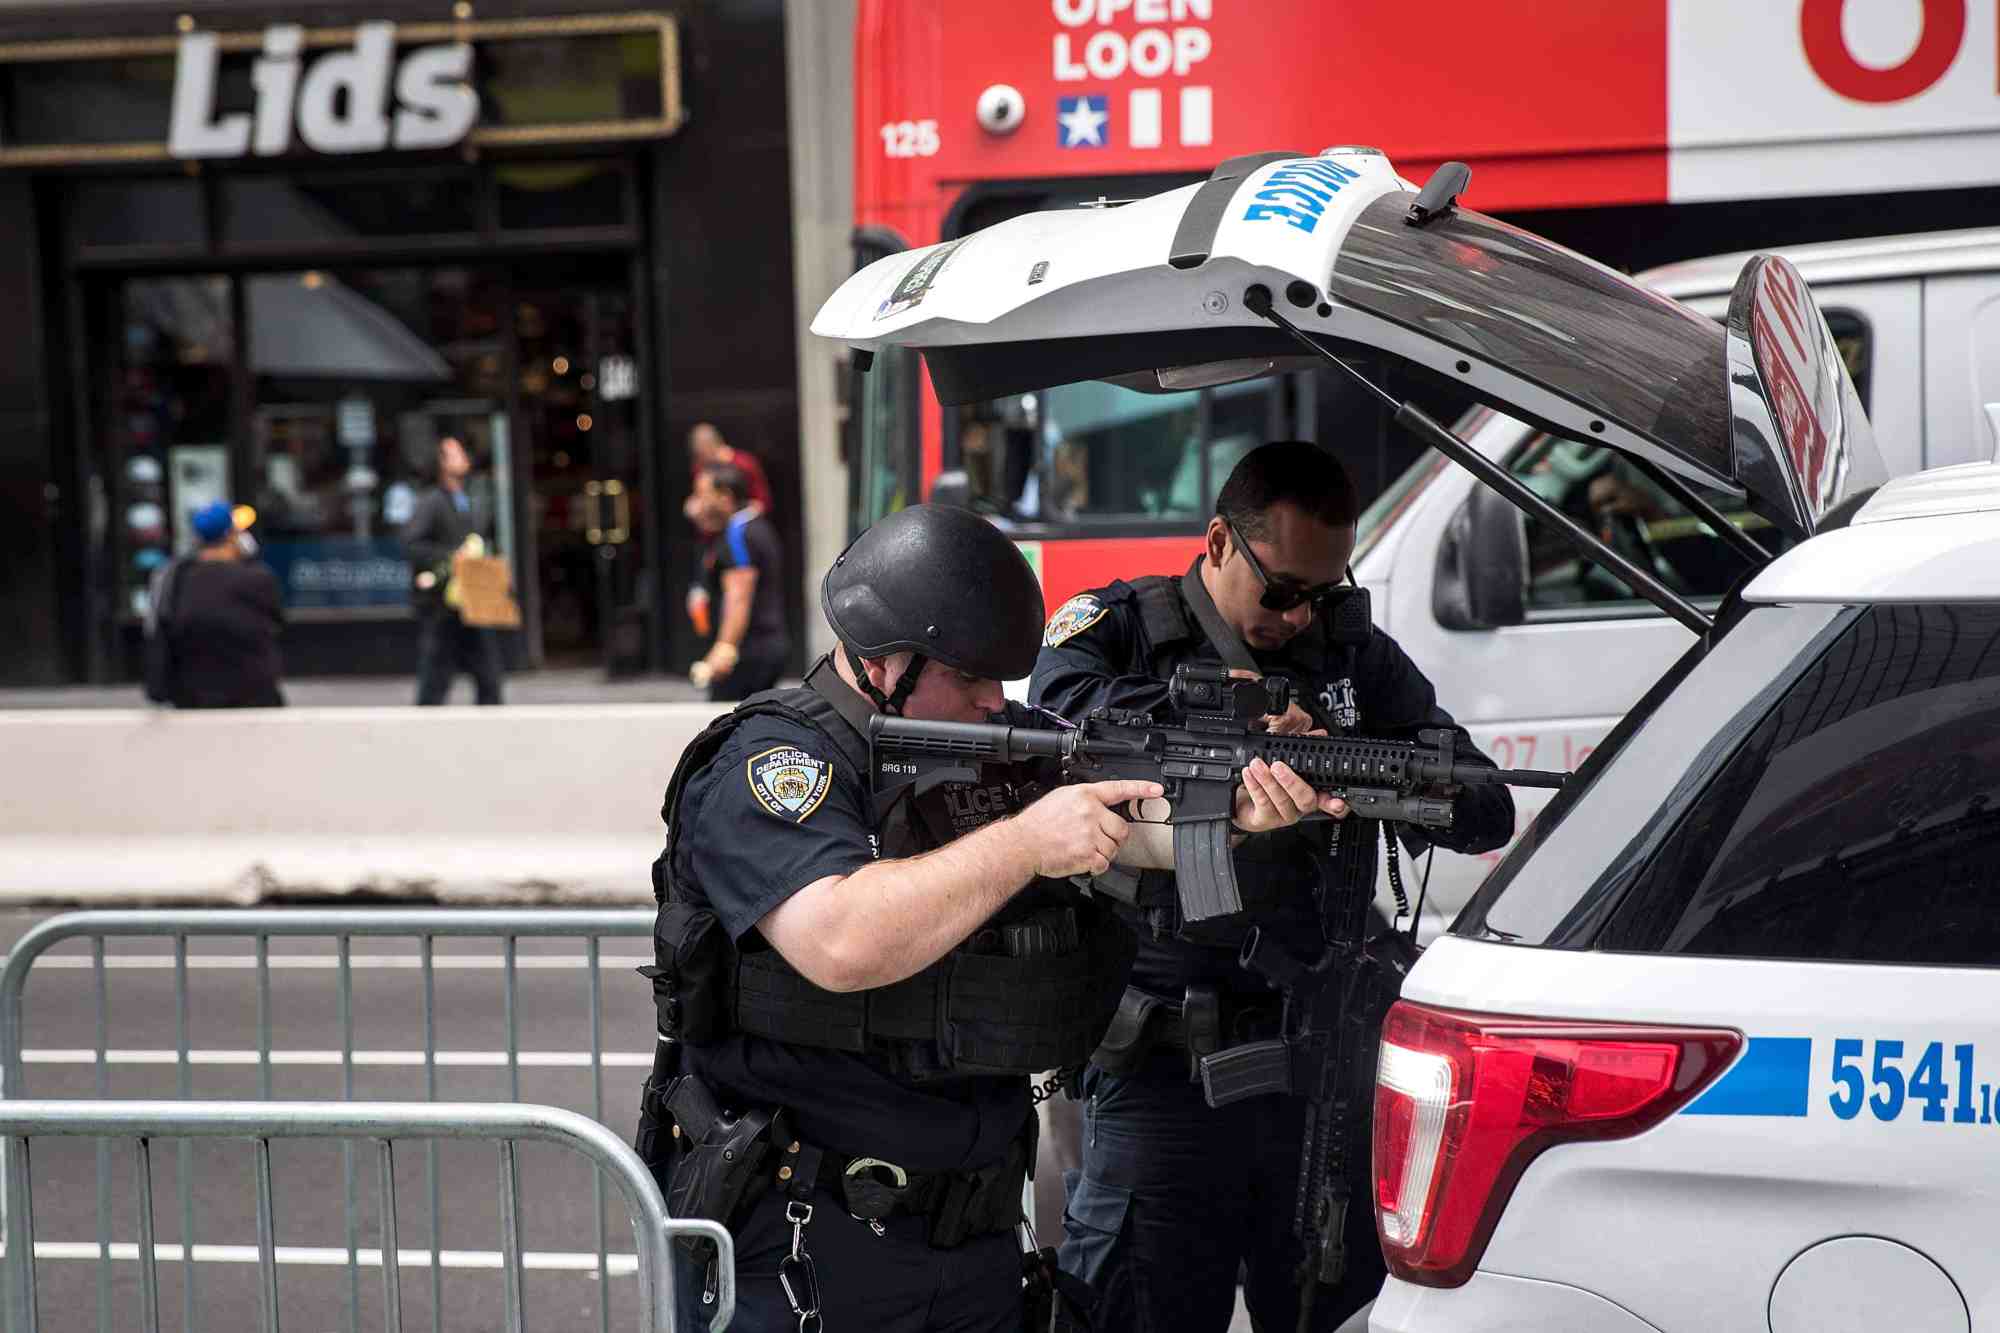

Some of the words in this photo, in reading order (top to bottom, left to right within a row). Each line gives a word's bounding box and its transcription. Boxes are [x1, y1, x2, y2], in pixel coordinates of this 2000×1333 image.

[1052, 27, 1213, 81] LOOP
[167, 19, 480, 159] Lids
[881, 120, 941, 157] 125
[1243, 159, 1361, 234] POLICE
[756, 758, 825, 776] DEPARTMENT
[769, 750, 809, 762] POLICE
[756, 783, 773, 801] CITY
[770, 801, 785, 813] OF
[813, 774, 828, 799] YORK
[1829, 1038, 1976, 1124] 5541
